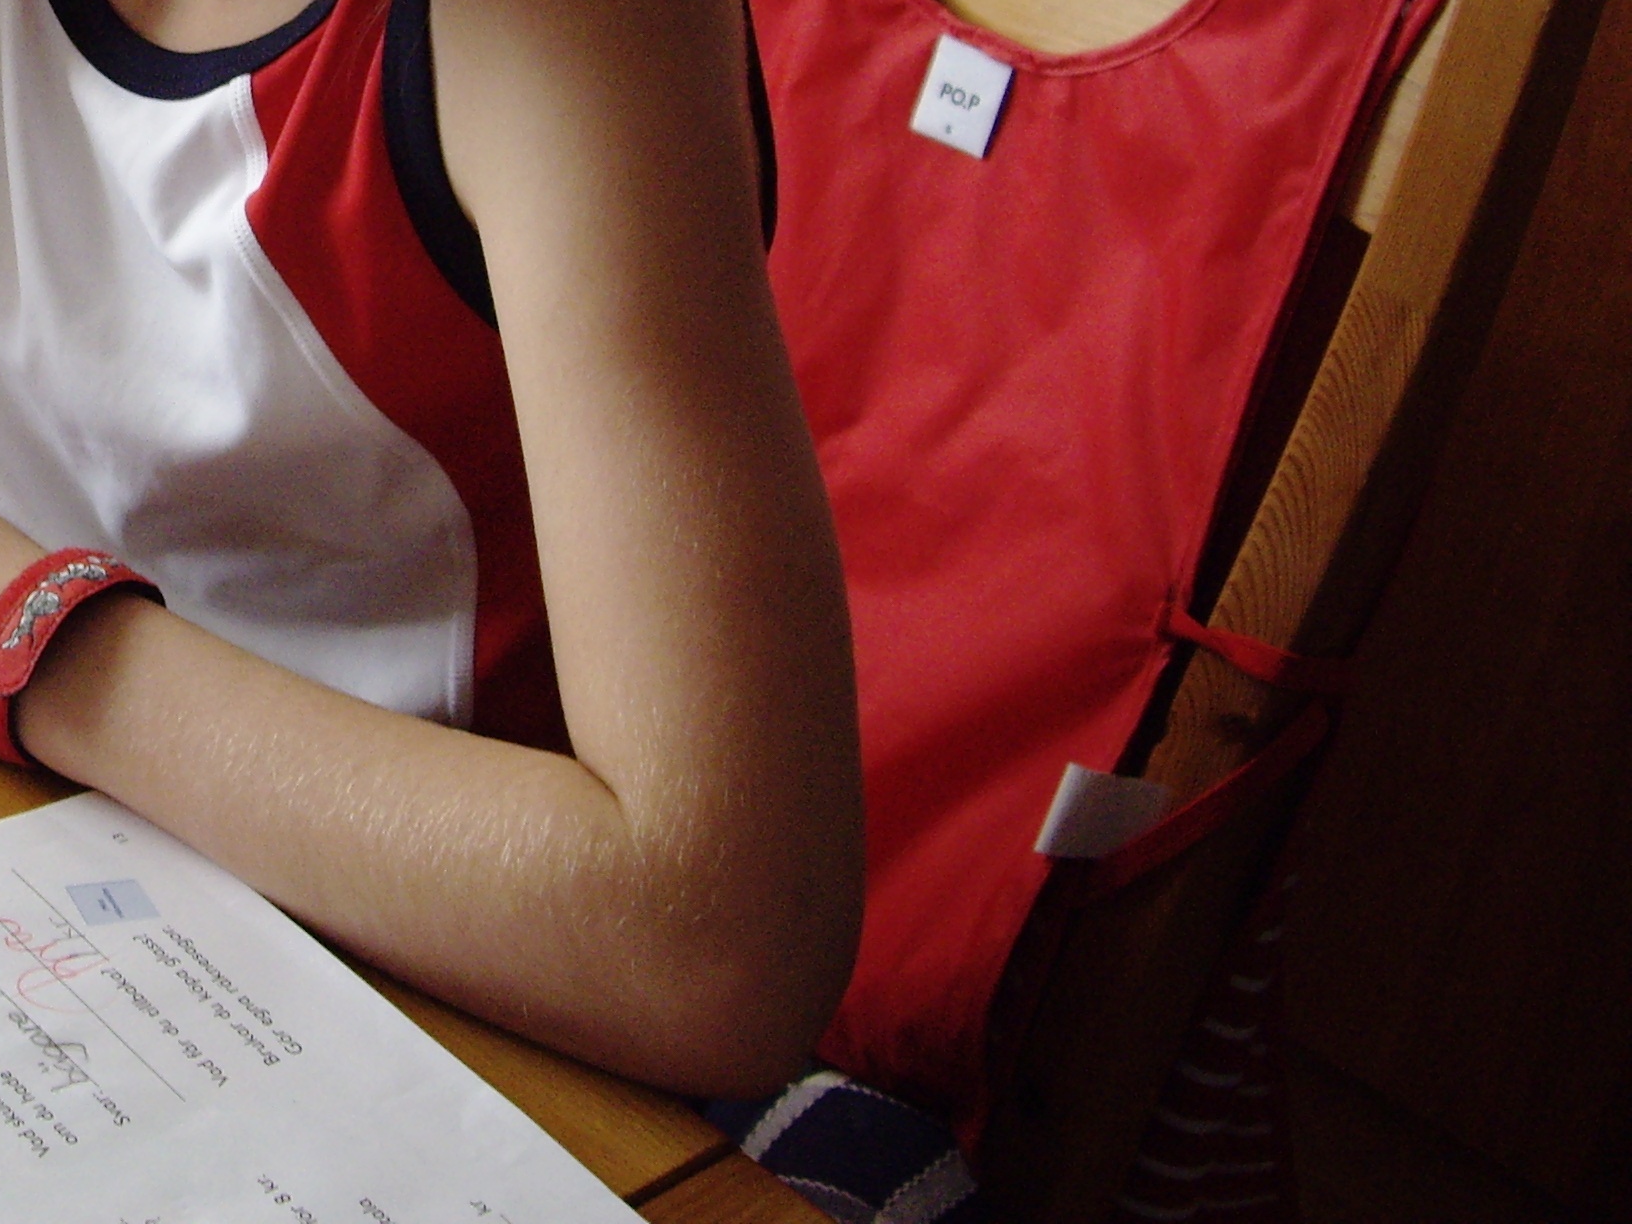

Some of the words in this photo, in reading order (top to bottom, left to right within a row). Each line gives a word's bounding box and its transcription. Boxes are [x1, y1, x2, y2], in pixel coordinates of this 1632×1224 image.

[938, 81, 981, 111] PO.P
[132, 934, 181, 967] glass?
[101, 968, 160, 1017] tillbaka?
[176, 969, 212, 1002] köpa
[211, 1002, 231, 1019] du
[238, 995, 273, 1026] egna
[159, 1019, 179, 1036] du
[8, 1007, 94, 1092] bägare
[178, 1040, 202, 1058] får
[230, 1024, 280, 1066] Brukar
[272, 1030, 303, 1055] Gör
[197, 1059, 228, 1087] Vad
[0, 1071, 35, 1104] hade
[34, 1104, 54, 1120] du
[93, 1091, 131, 1126] Svar:
[18, 1129, 49, 1158] Vad
[53, 1123, 78, 1144] om
[257, 1174, 279, 1194] kr.
[274, 1192, 291, 1205] 8
[470, 1200, 492, 1216] kr
